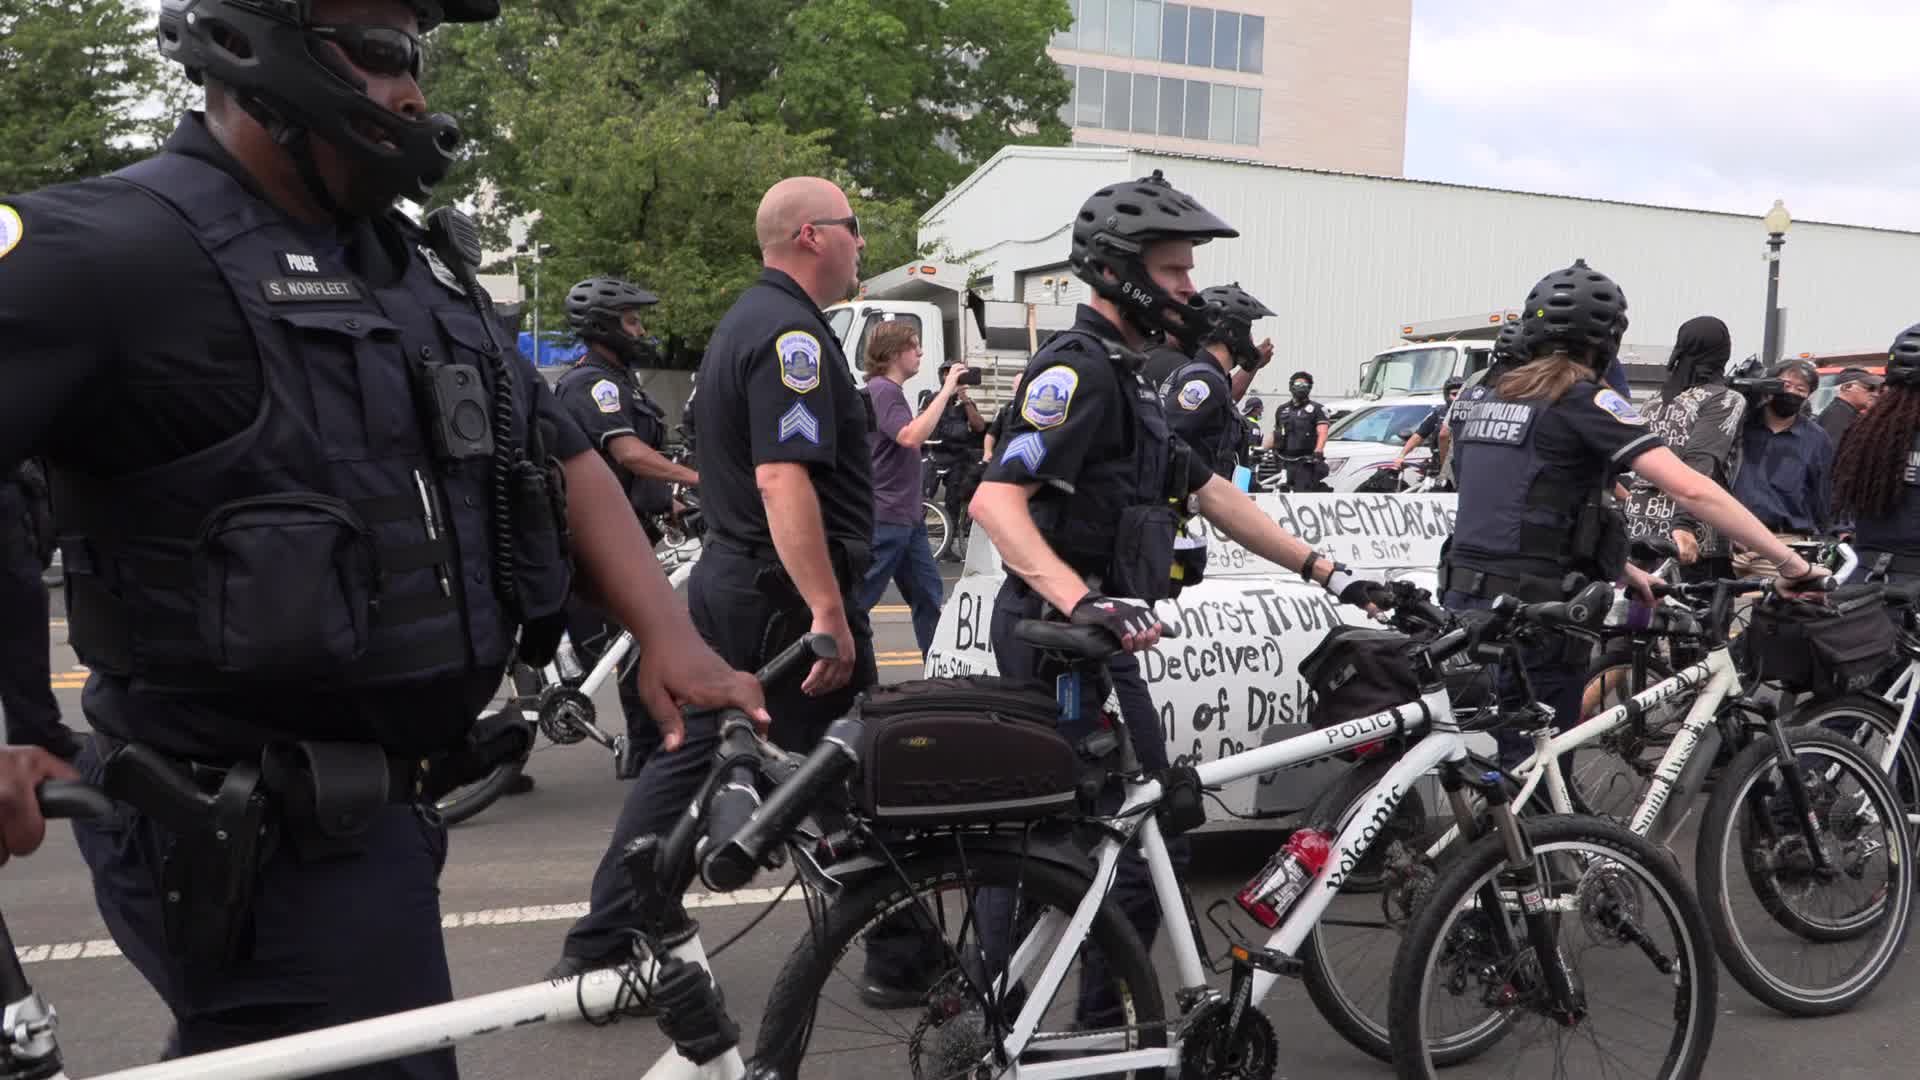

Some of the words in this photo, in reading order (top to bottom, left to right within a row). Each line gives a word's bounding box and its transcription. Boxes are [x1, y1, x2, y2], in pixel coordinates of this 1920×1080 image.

[269, 282, 287, 295] S.
[287, 282, 350, 295] NORFLEET
[1122, 281, 1133, 294] S
[1131, 288, 1153, 307] 942
[1461, 420, 1522, 441] POLICE
[1646, 497, 1676, 519] Bibl
[1351, 543, 1361, 561] A
[1193, 687, 1230, 732] of
[1326, 712, 1394, 744] POLIC
